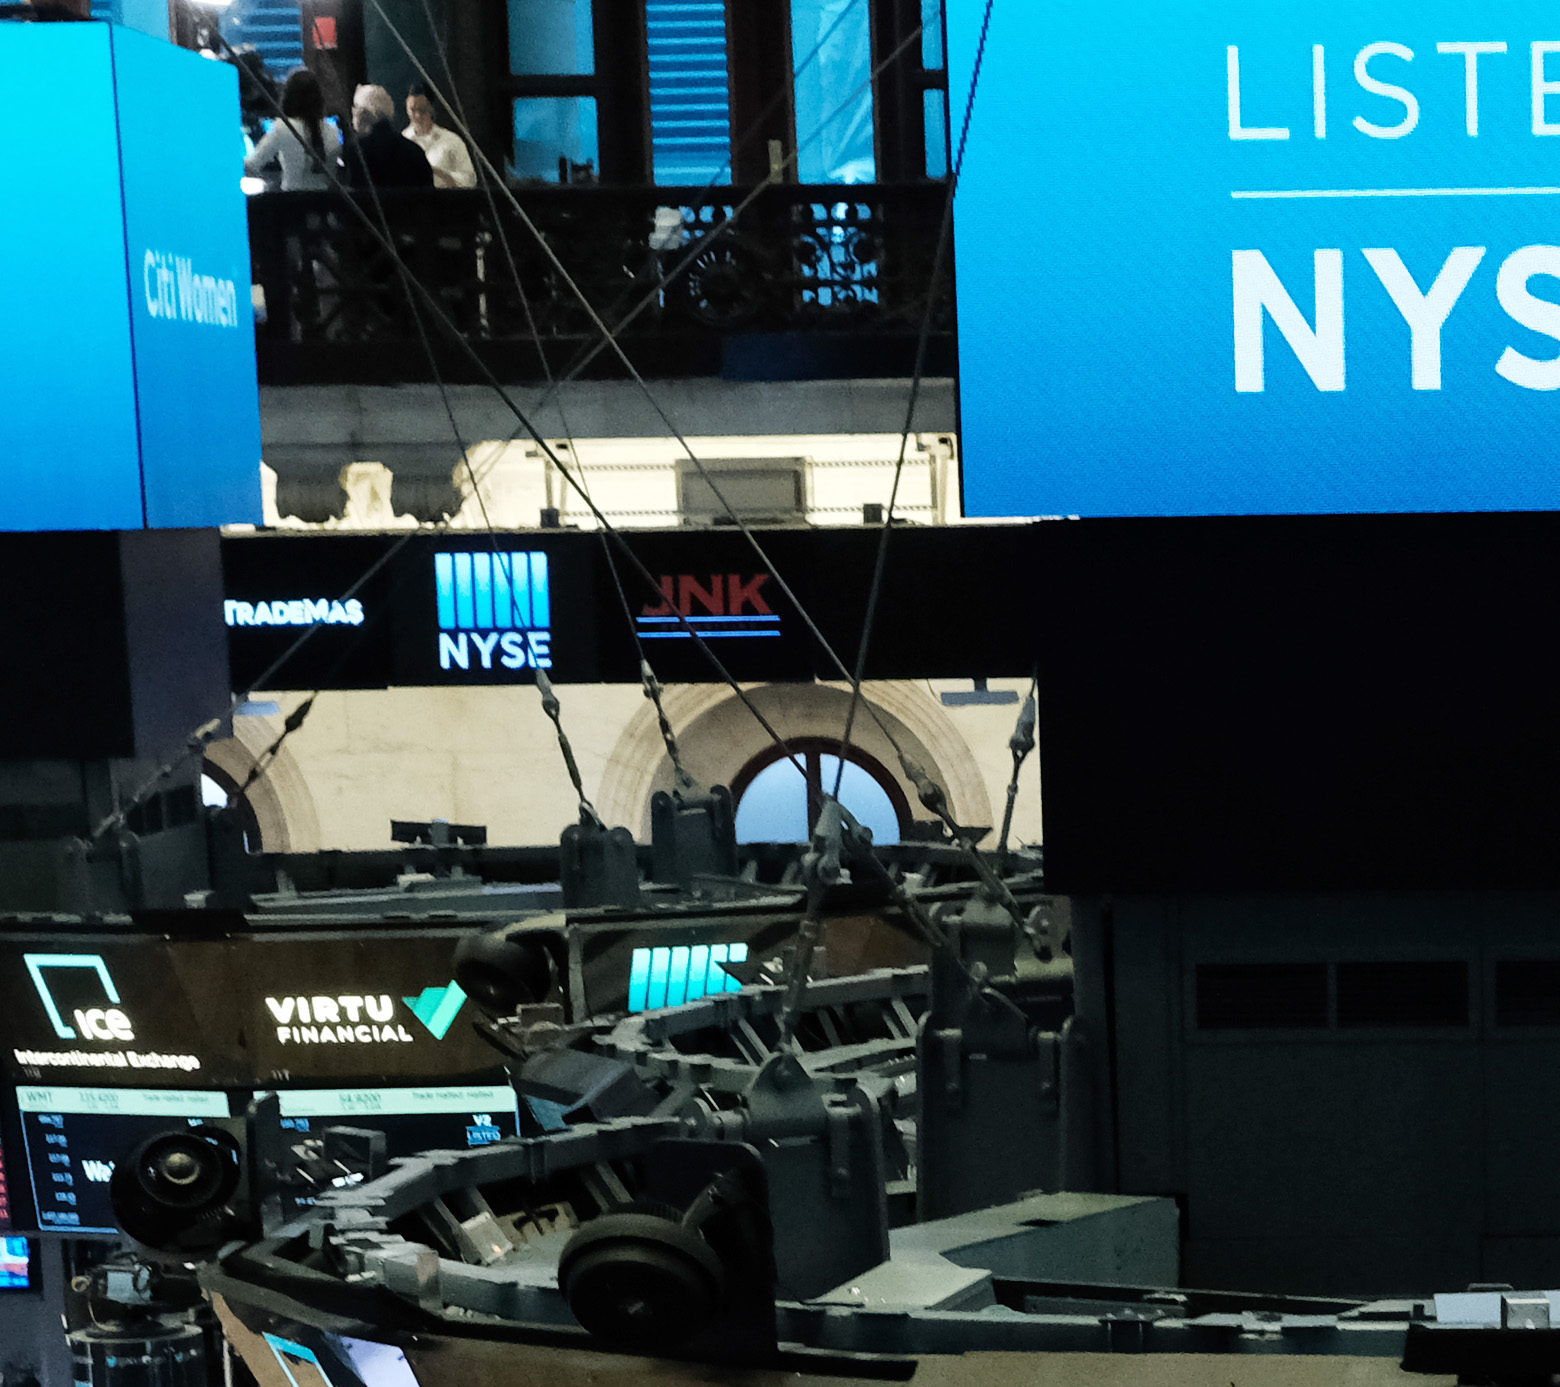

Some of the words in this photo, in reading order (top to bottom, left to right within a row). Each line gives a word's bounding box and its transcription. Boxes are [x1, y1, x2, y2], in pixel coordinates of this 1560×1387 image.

[143, 248, 175, 324] Citi
[179, 256, 238, 327] Women
[641, 574, 772, 616] JNK
[438, 631, 552, 671] NYSE
[266, 996, 394, 1025] VIRTU
[276, 1025, 413, 1044] FINANCIAL
